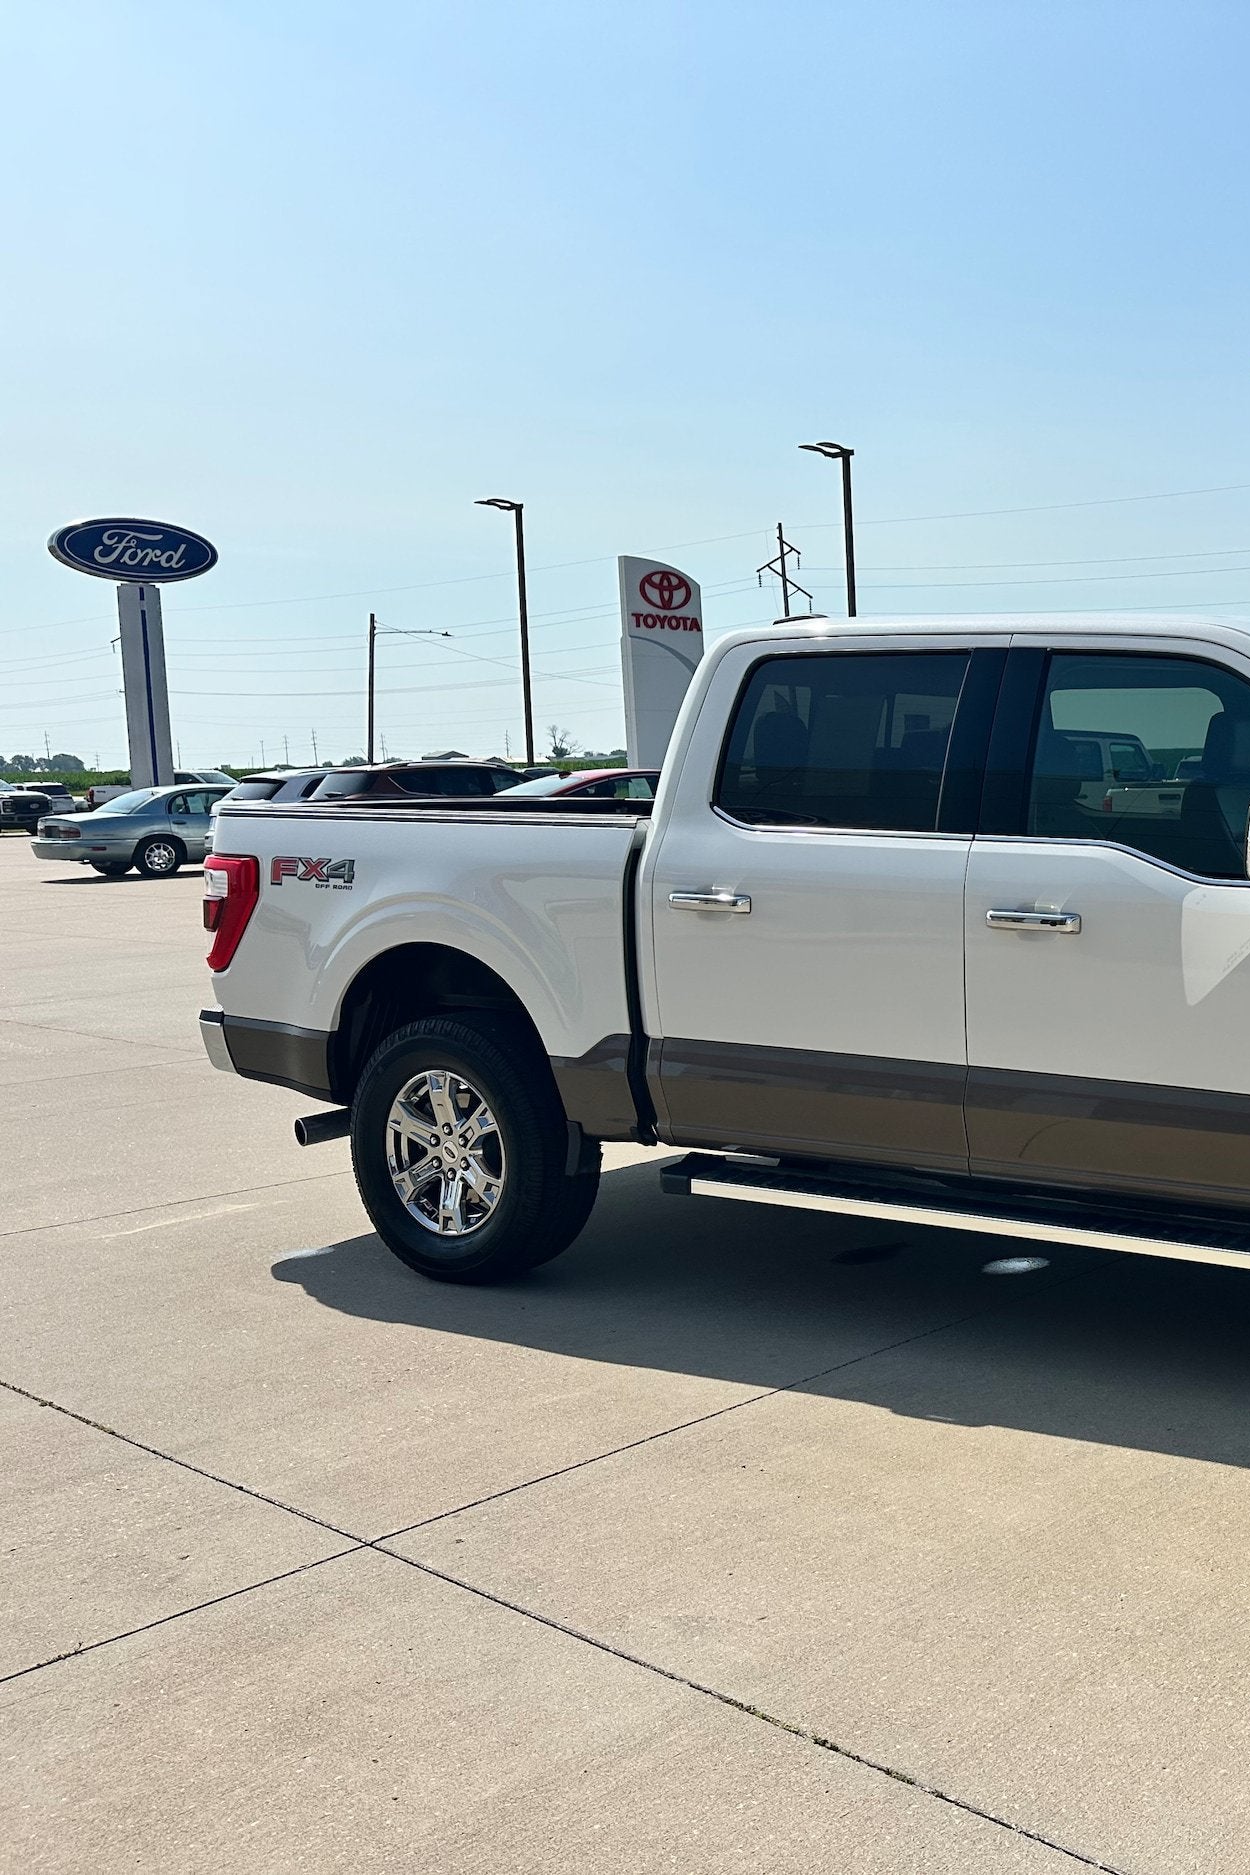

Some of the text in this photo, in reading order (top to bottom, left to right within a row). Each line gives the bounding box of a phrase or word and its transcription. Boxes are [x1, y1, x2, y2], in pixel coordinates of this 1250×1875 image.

[93, 529, 187, 569] Ford
[631, 612, 702, 632] TOYOTA
[271, 856, 355, 886] FX4
